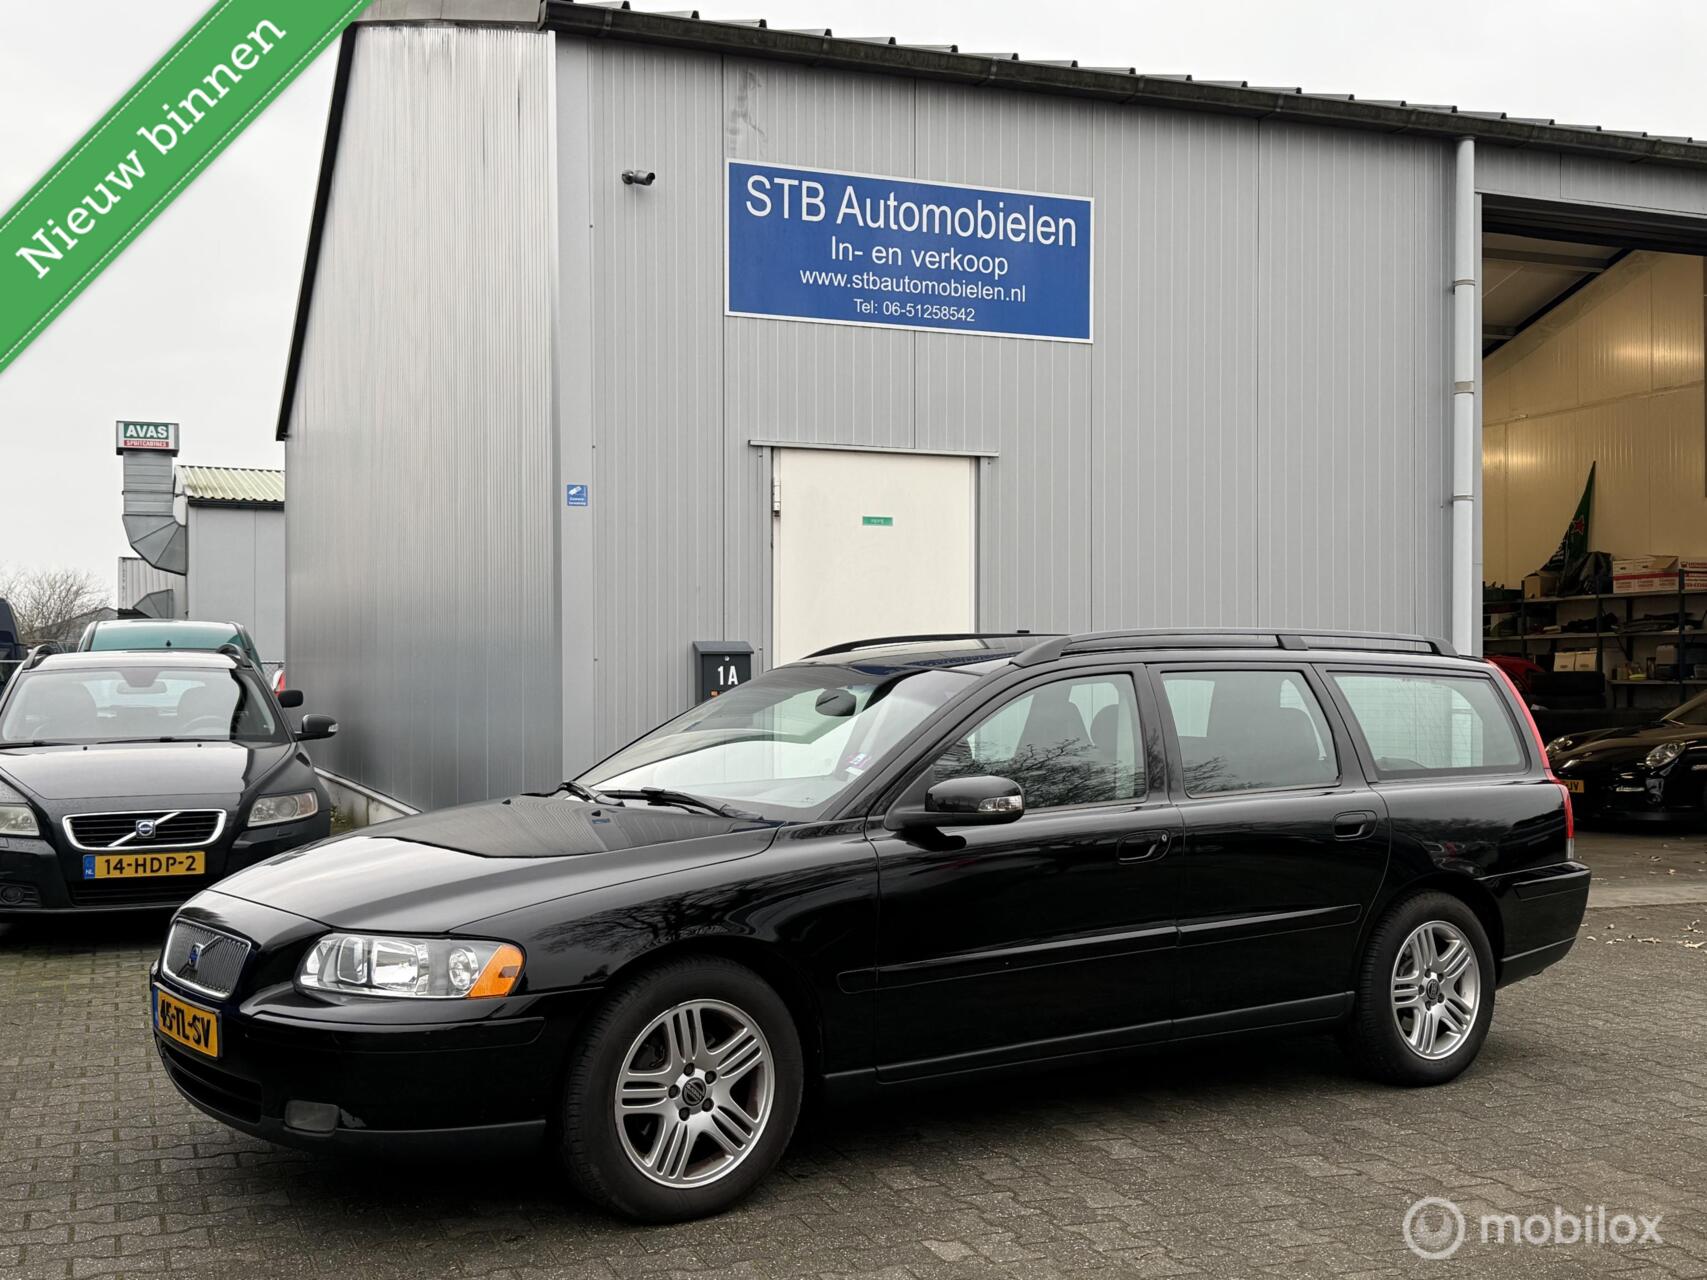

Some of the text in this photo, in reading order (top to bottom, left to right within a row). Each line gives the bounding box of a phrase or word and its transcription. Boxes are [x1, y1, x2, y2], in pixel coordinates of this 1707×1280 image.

[745, 174, 1077, 247] STB Automobielen
[831, 236, 1009, 281] In- en verkoop
[800, 269, 1026, 303] www.stbautomobielen.nl
[853, 298, 976, 323] Tel: 06-51258542
[126, 425, 167, 438] AVAS
[717, 665, 738, 685] 1A
[105, 855, 197, 875] 14-HDP-2
[160, 998, 212, 1050] 45-TL-SV
